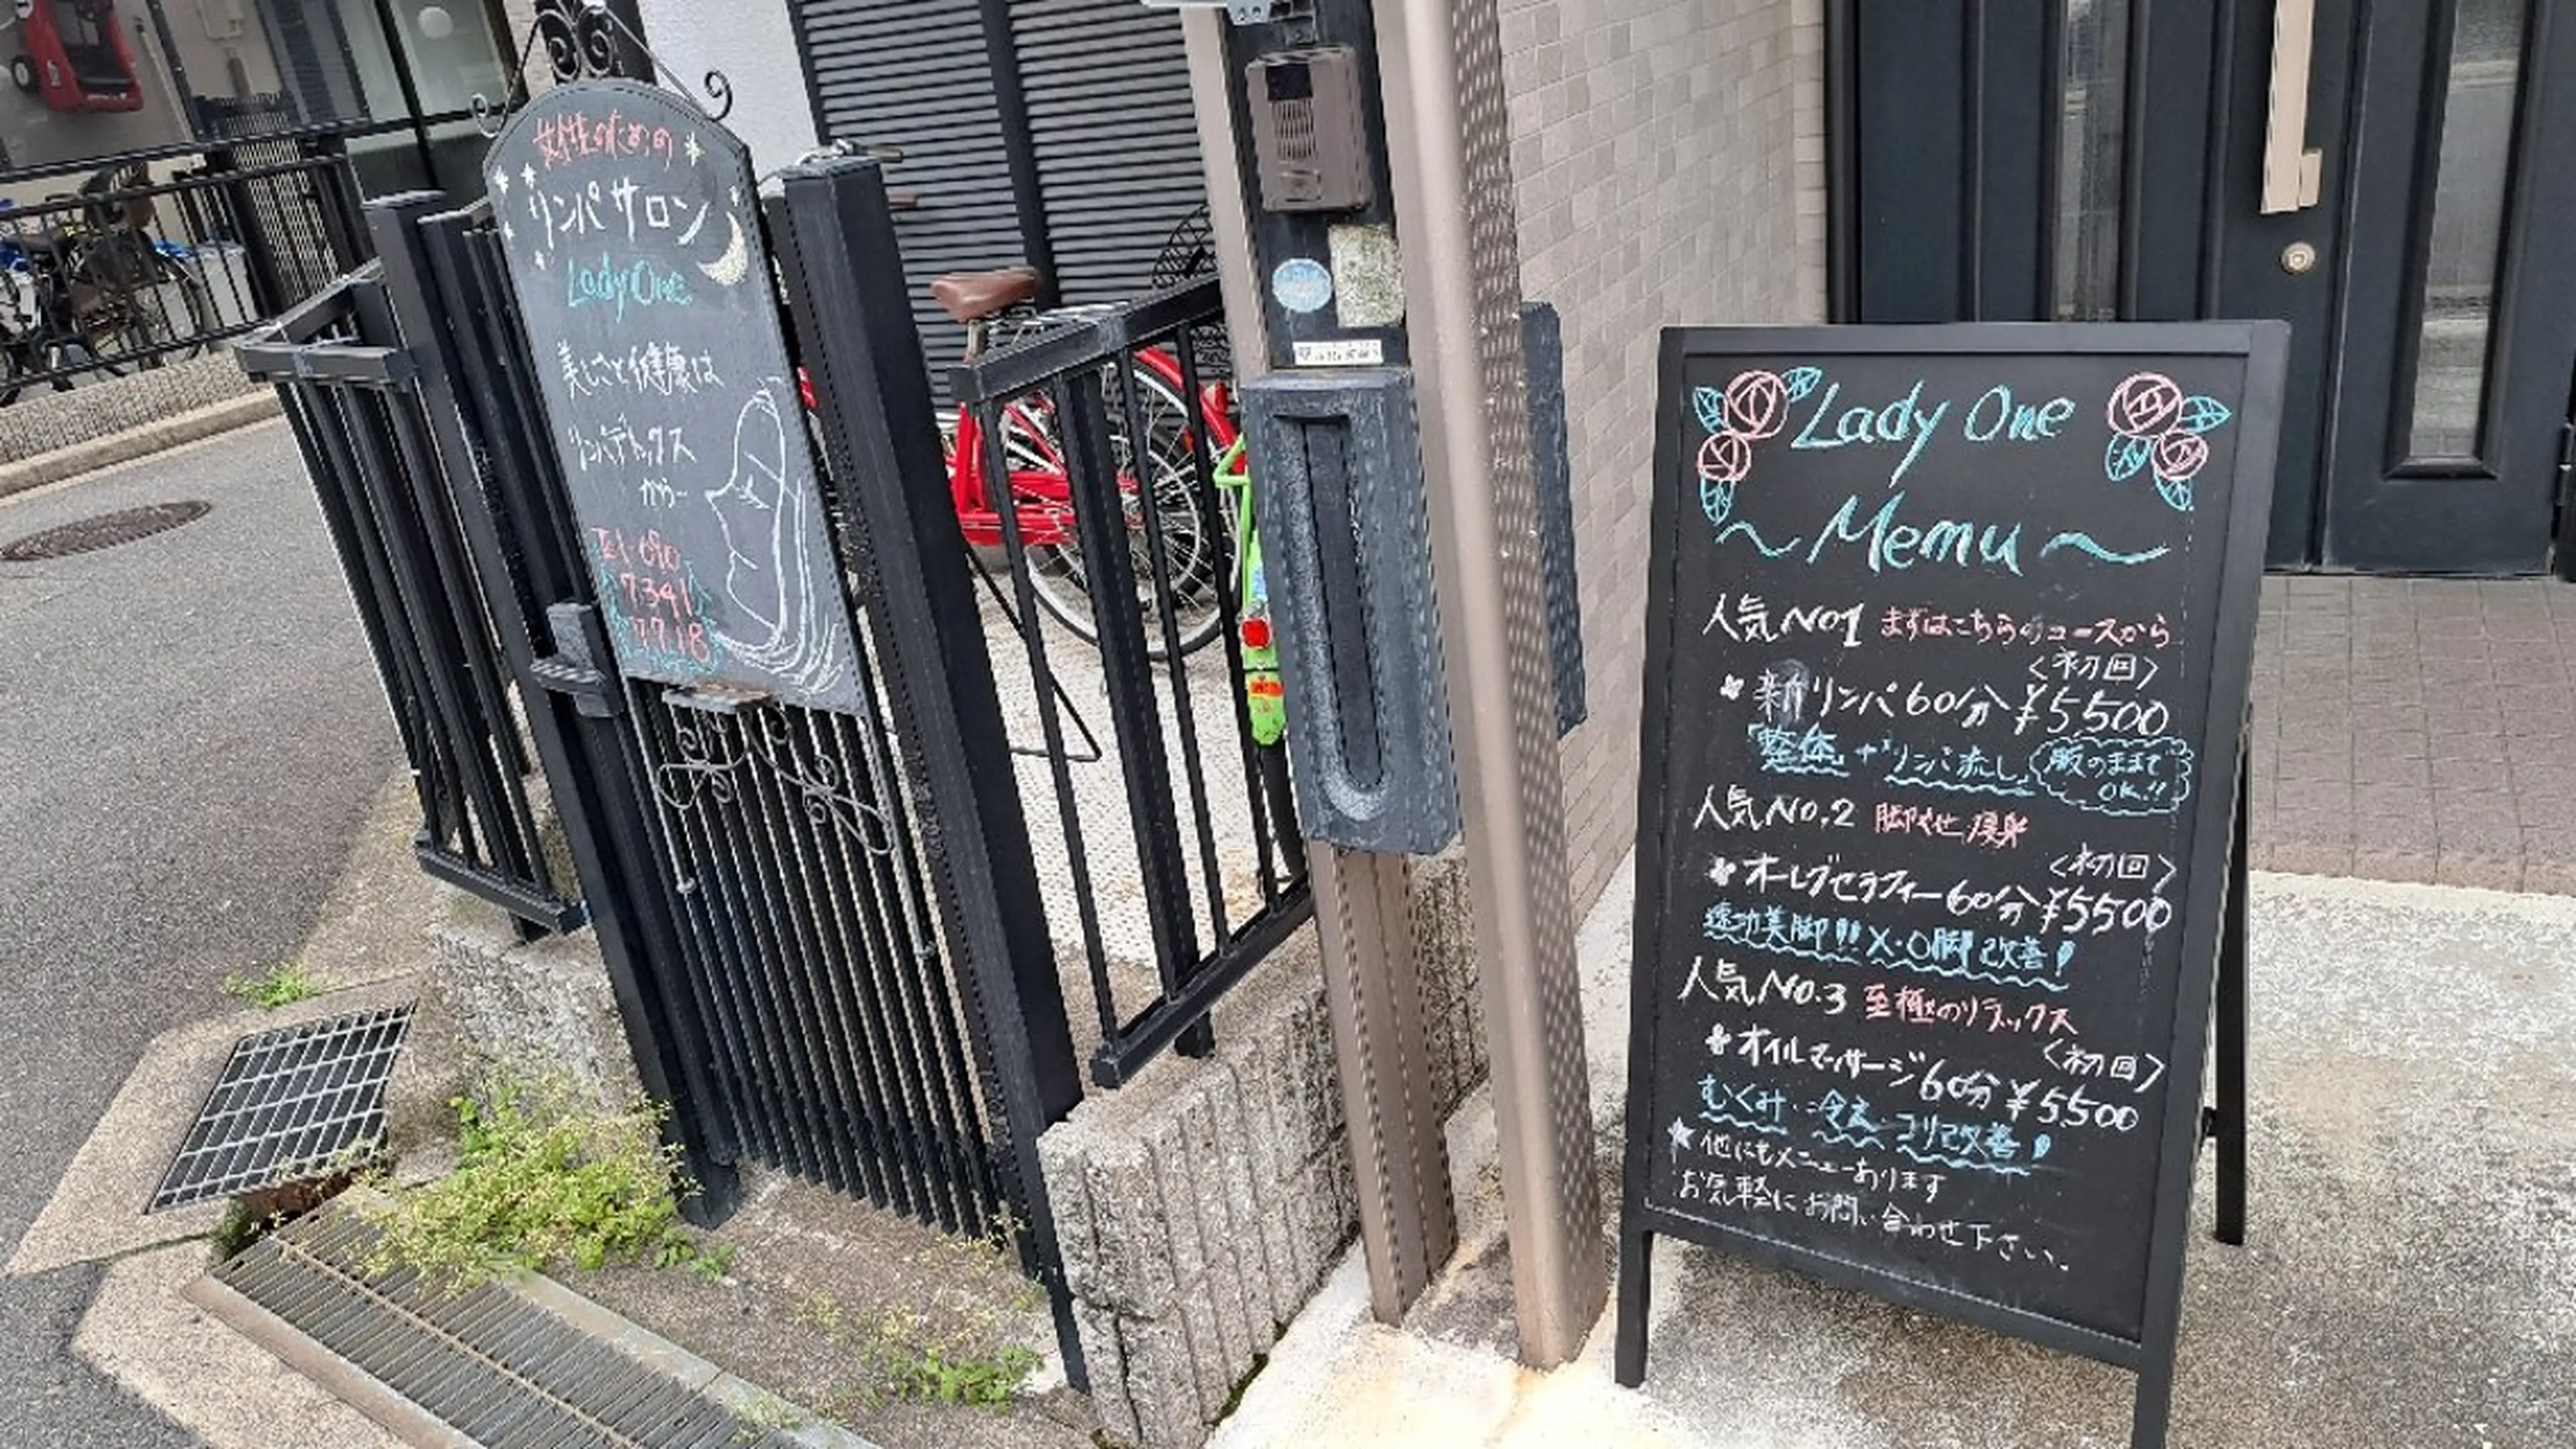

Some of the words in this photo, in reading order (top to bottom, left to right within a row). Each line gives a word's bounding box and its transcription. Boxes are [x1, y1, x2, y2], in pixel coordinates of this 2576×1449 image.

[529, 176, 709, 250] リンパサロン
[568, 251, 629, 324] Lady
[630, 259, 693, 307] One
[1790, 379, 1951, 489] Lady
[1963, 384, 2076, 443] One
